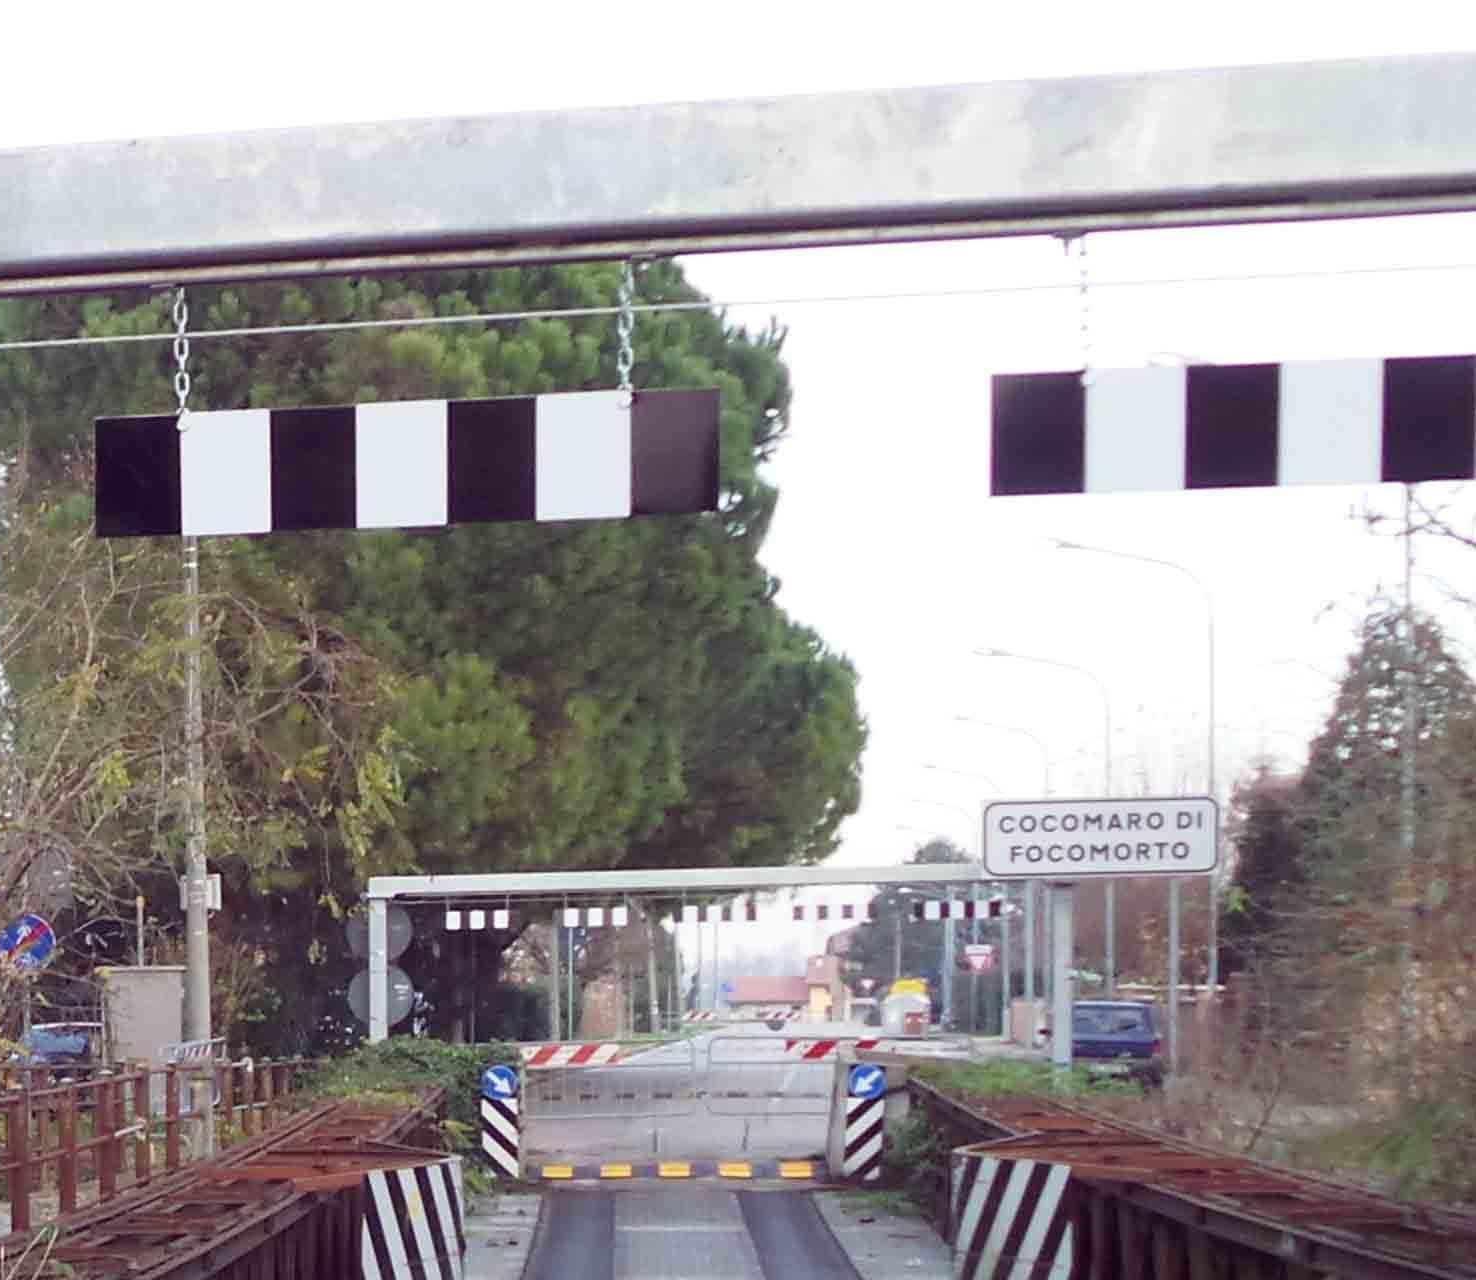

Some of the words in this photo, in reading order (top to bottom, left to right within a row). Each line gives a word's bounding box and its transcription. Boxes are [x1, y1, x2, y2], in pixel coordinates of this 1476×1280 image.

[999, 811, 1165, 833] COCOMARO
[1176, 811, 1203, 829] DI
[1010, 841, 1190, 864] FOCOMORTO
